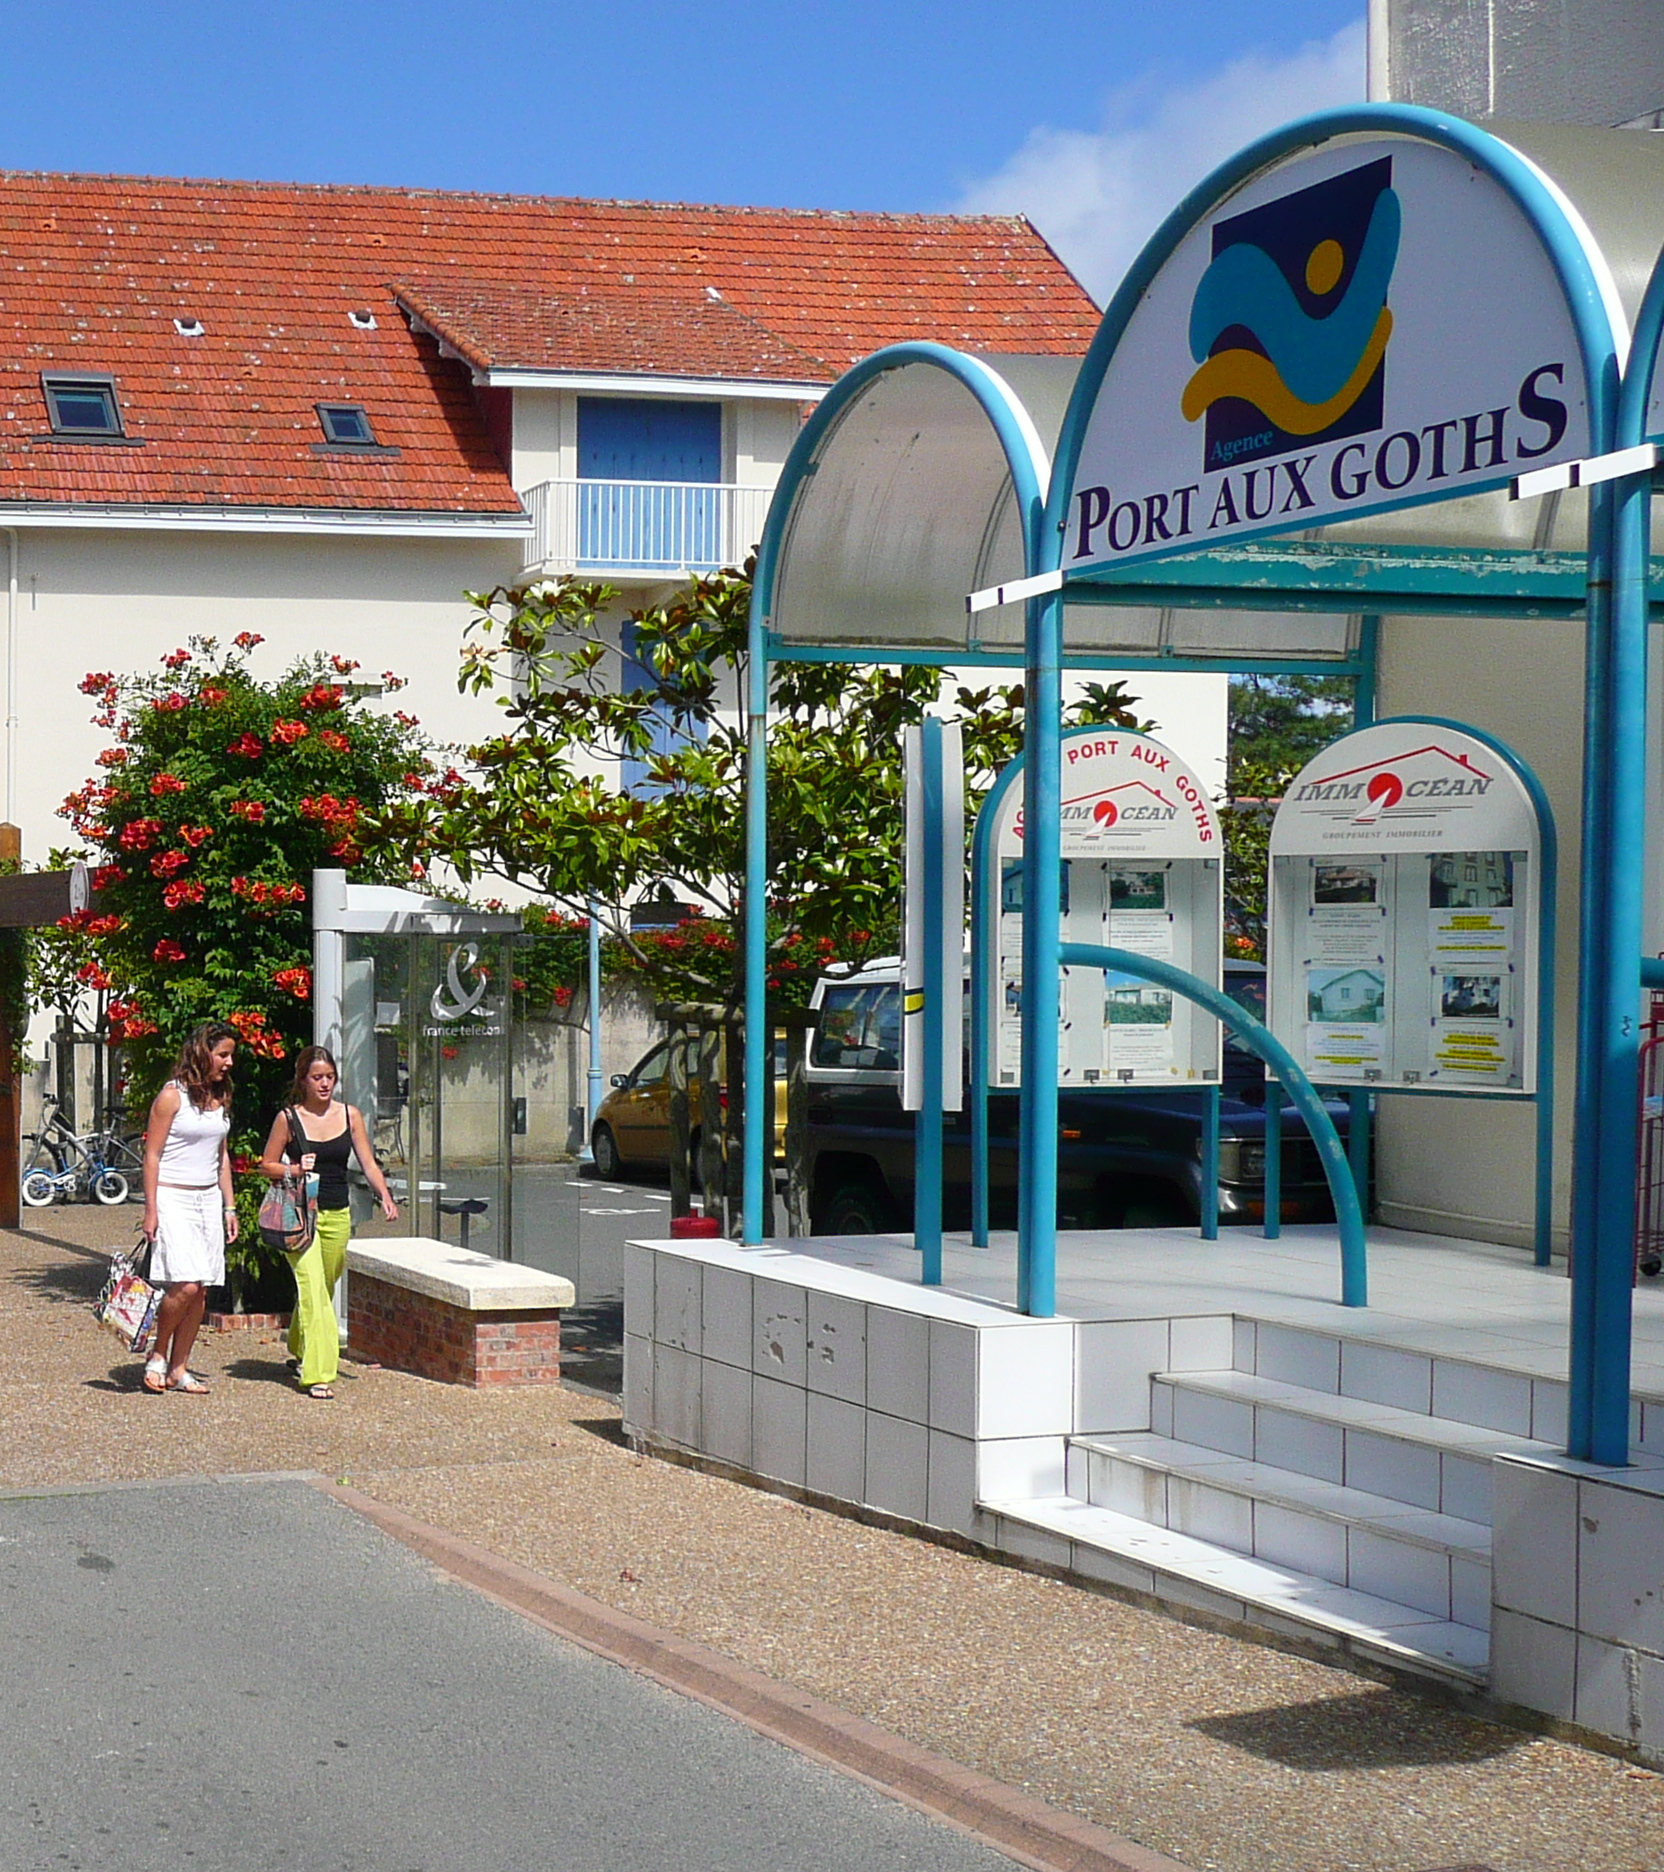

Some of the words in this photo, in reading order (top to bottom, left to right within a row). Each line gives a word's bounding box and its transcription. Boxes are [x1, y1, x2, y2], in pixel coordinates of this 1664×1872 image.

[1071, 483, 1200, 560] PORT
[1206, 454, 1319, 531] AUX
[1329, 362, 1569, 501] GOTHS
[1210, 430, 1274, 462] Agence
[1066, 740, 1119, 764] PORT
[1130, 744, 1171, 773] AUX
[1175, 775, 1213, 842] GOTHS
[422, 1024, 457, 1037] france
